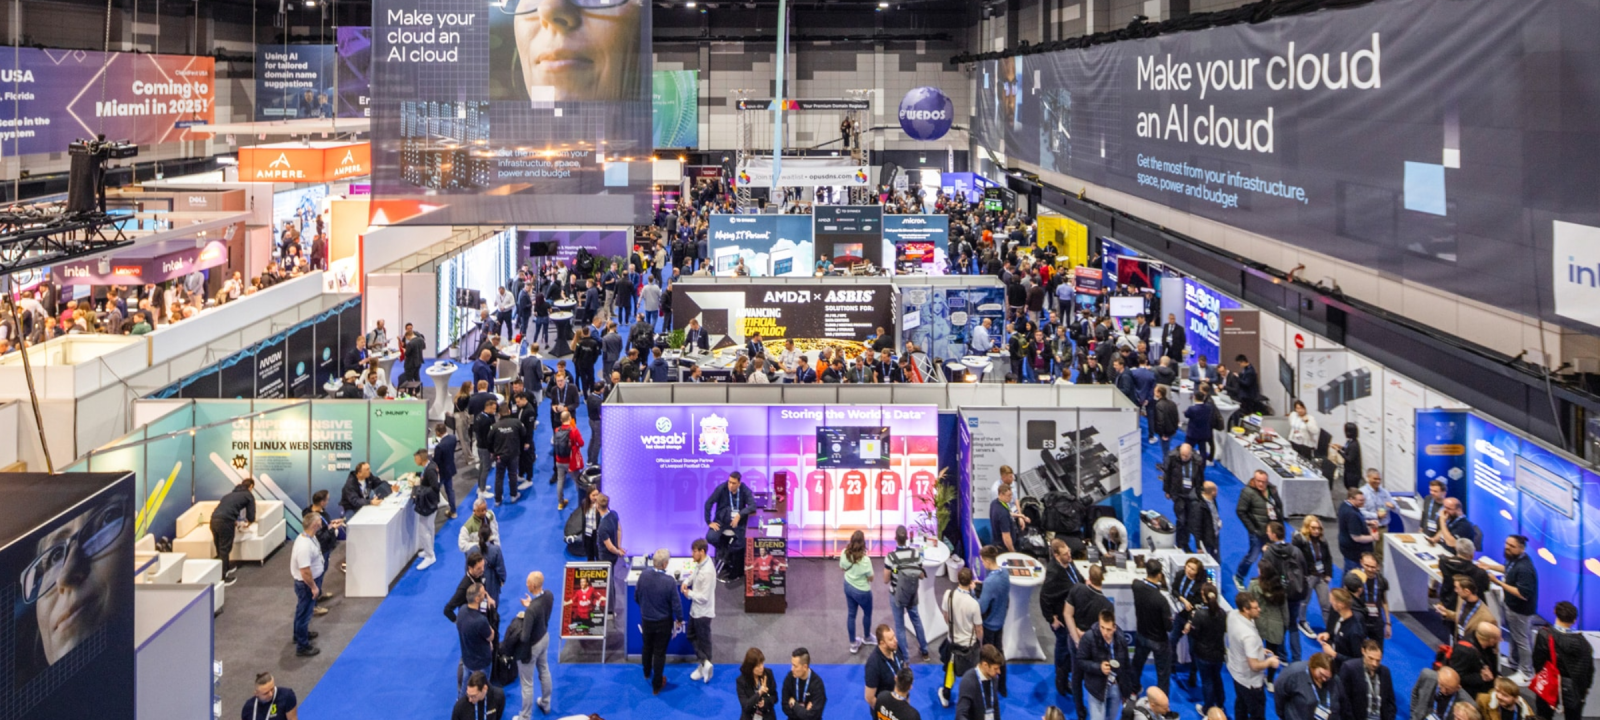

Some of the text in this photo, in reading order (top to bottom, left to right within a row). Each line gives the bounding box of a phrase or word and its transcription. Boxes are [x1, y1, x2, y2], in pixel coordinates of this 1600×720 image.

[387, 9, 475, 29] Make your
[387, 27, 460, 44] cloud an
[264, 52, 298, 62] Using AI
[387, 46, 458, 62] AI cloud
[278, 61, 309, 70] tailored
[1137, 32, 1381, 100] Make your cloud
[1, 69, 35, 83] USA
[264, 70, 294, 78] domain
[132, 79, 209, 99] Coming to
[264, 80, 314, 89] suggestions
[95, 98, 209, 117] Miami in 2025!
[906, 110, 946, 120] WEDOS
[24, 117, 34, 126] in
[35, 117, 50, 125] the
[1136, 103, 1274, 154] an AI cloud
[498, 159, 553, 168] infrastructure,
[498, 169, 571, 178] power and budget
[809, 173, 853, 181] opusdns.com
[1137, 153, 1309, 205] Get the most from your infrastructure,
[1137, 171, 1239, 209] space, power and budget
[780, 409, 824, 420] Storing
[825, 409, 845, 419] the
[847, 409, 891, 419] World's
[311, 430, 353, 440] SUITE
[641, 432, 687, 444] wasabi
[231, 441, 353, 450] FOR LINUX WEB SERVERS
[1043, 439, 1055, 448] ES
[815, 480, 824, 494] 4
[846, 480, 861, 495] 23
[881, 480, 895, 494] 20
[915, 480, 930, 495] 17
[575, 570, 608, 578] LEGEND
